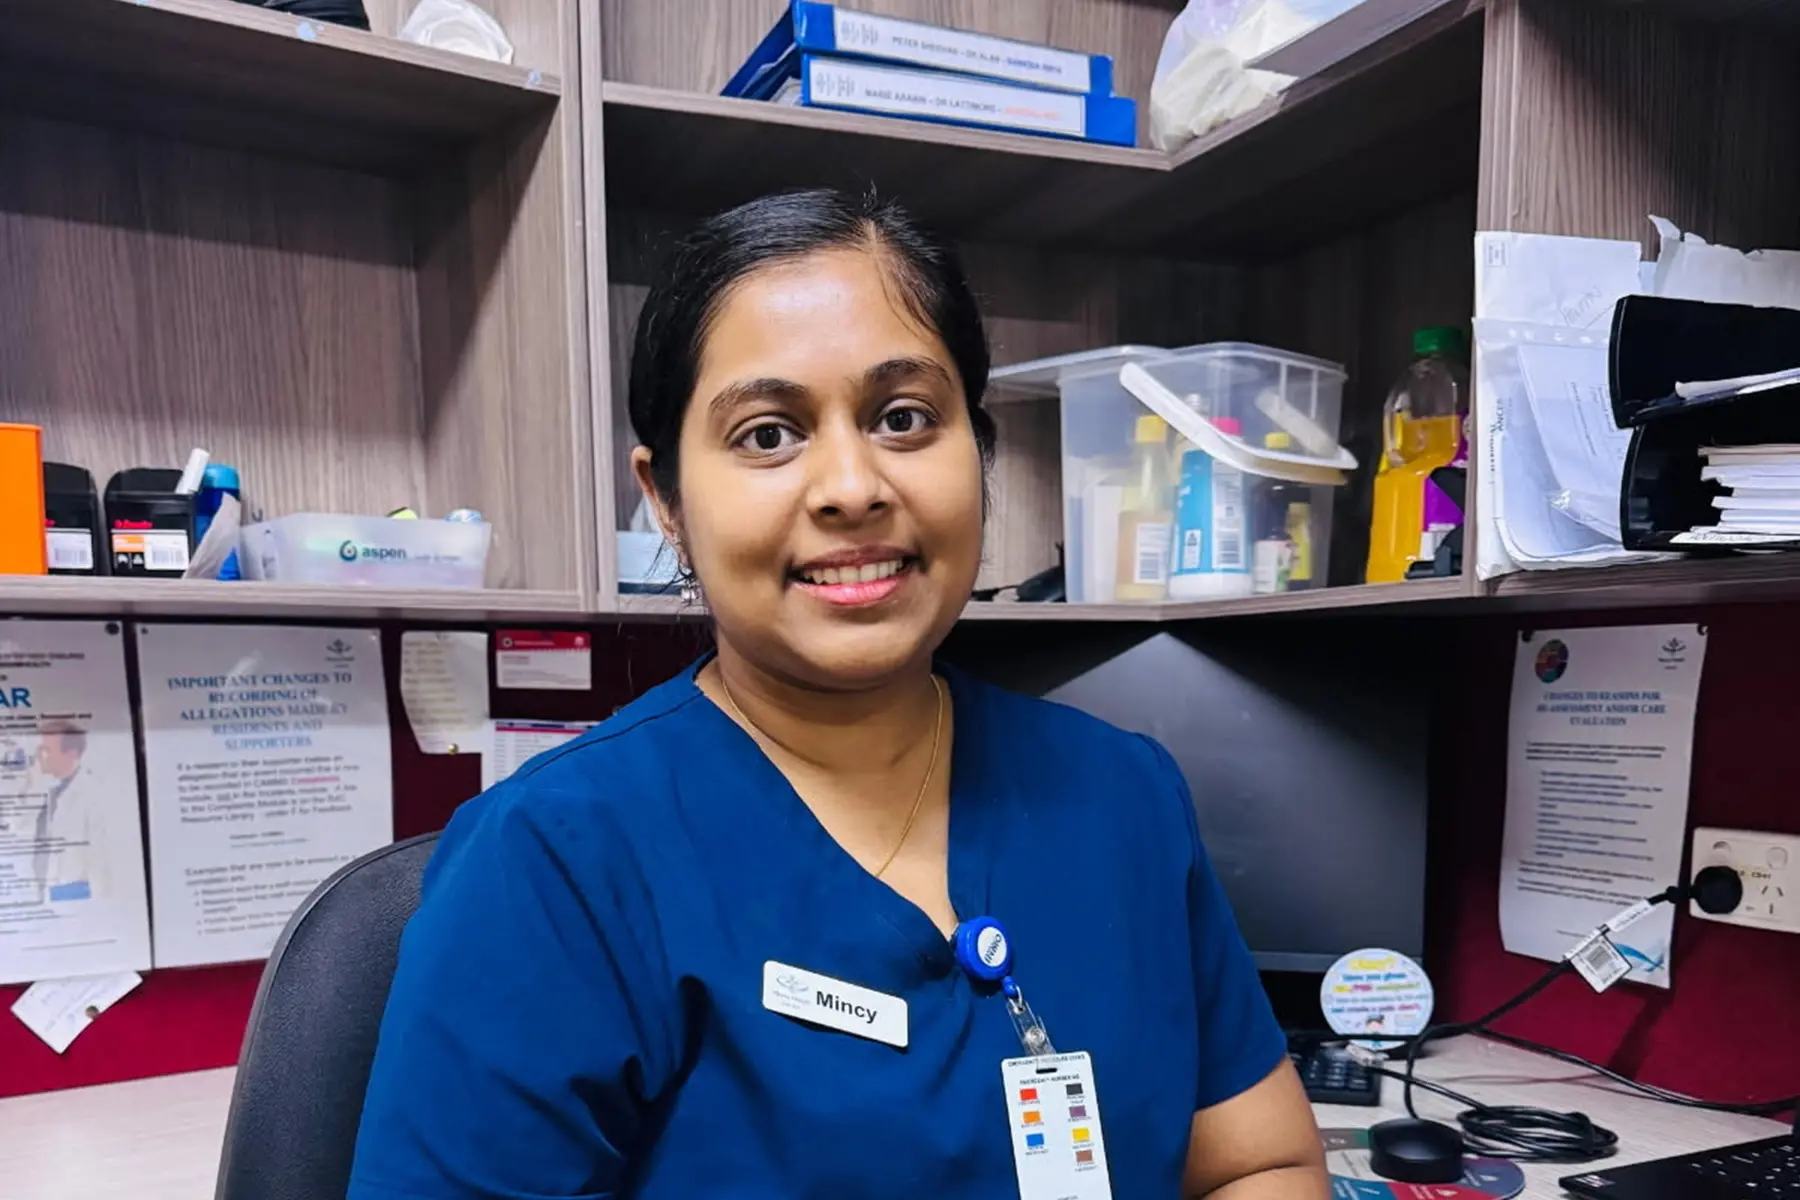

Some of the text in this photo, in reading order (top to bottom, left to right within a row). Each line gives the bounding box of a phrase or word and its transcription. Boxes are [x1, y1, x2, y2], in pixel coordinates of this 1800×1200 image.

[362, 547, 406, 560] aspen
[168, 671, 353, 690] IMPORTANT CHANGES TO
[180, 705, 285, 721] ALLEGATIONS
[212, 718, 323, 735] RESIDENTS AND
[225, 735, 313, 751] SUPPORTERS
[816, 991, 877, 1024] Mincy
